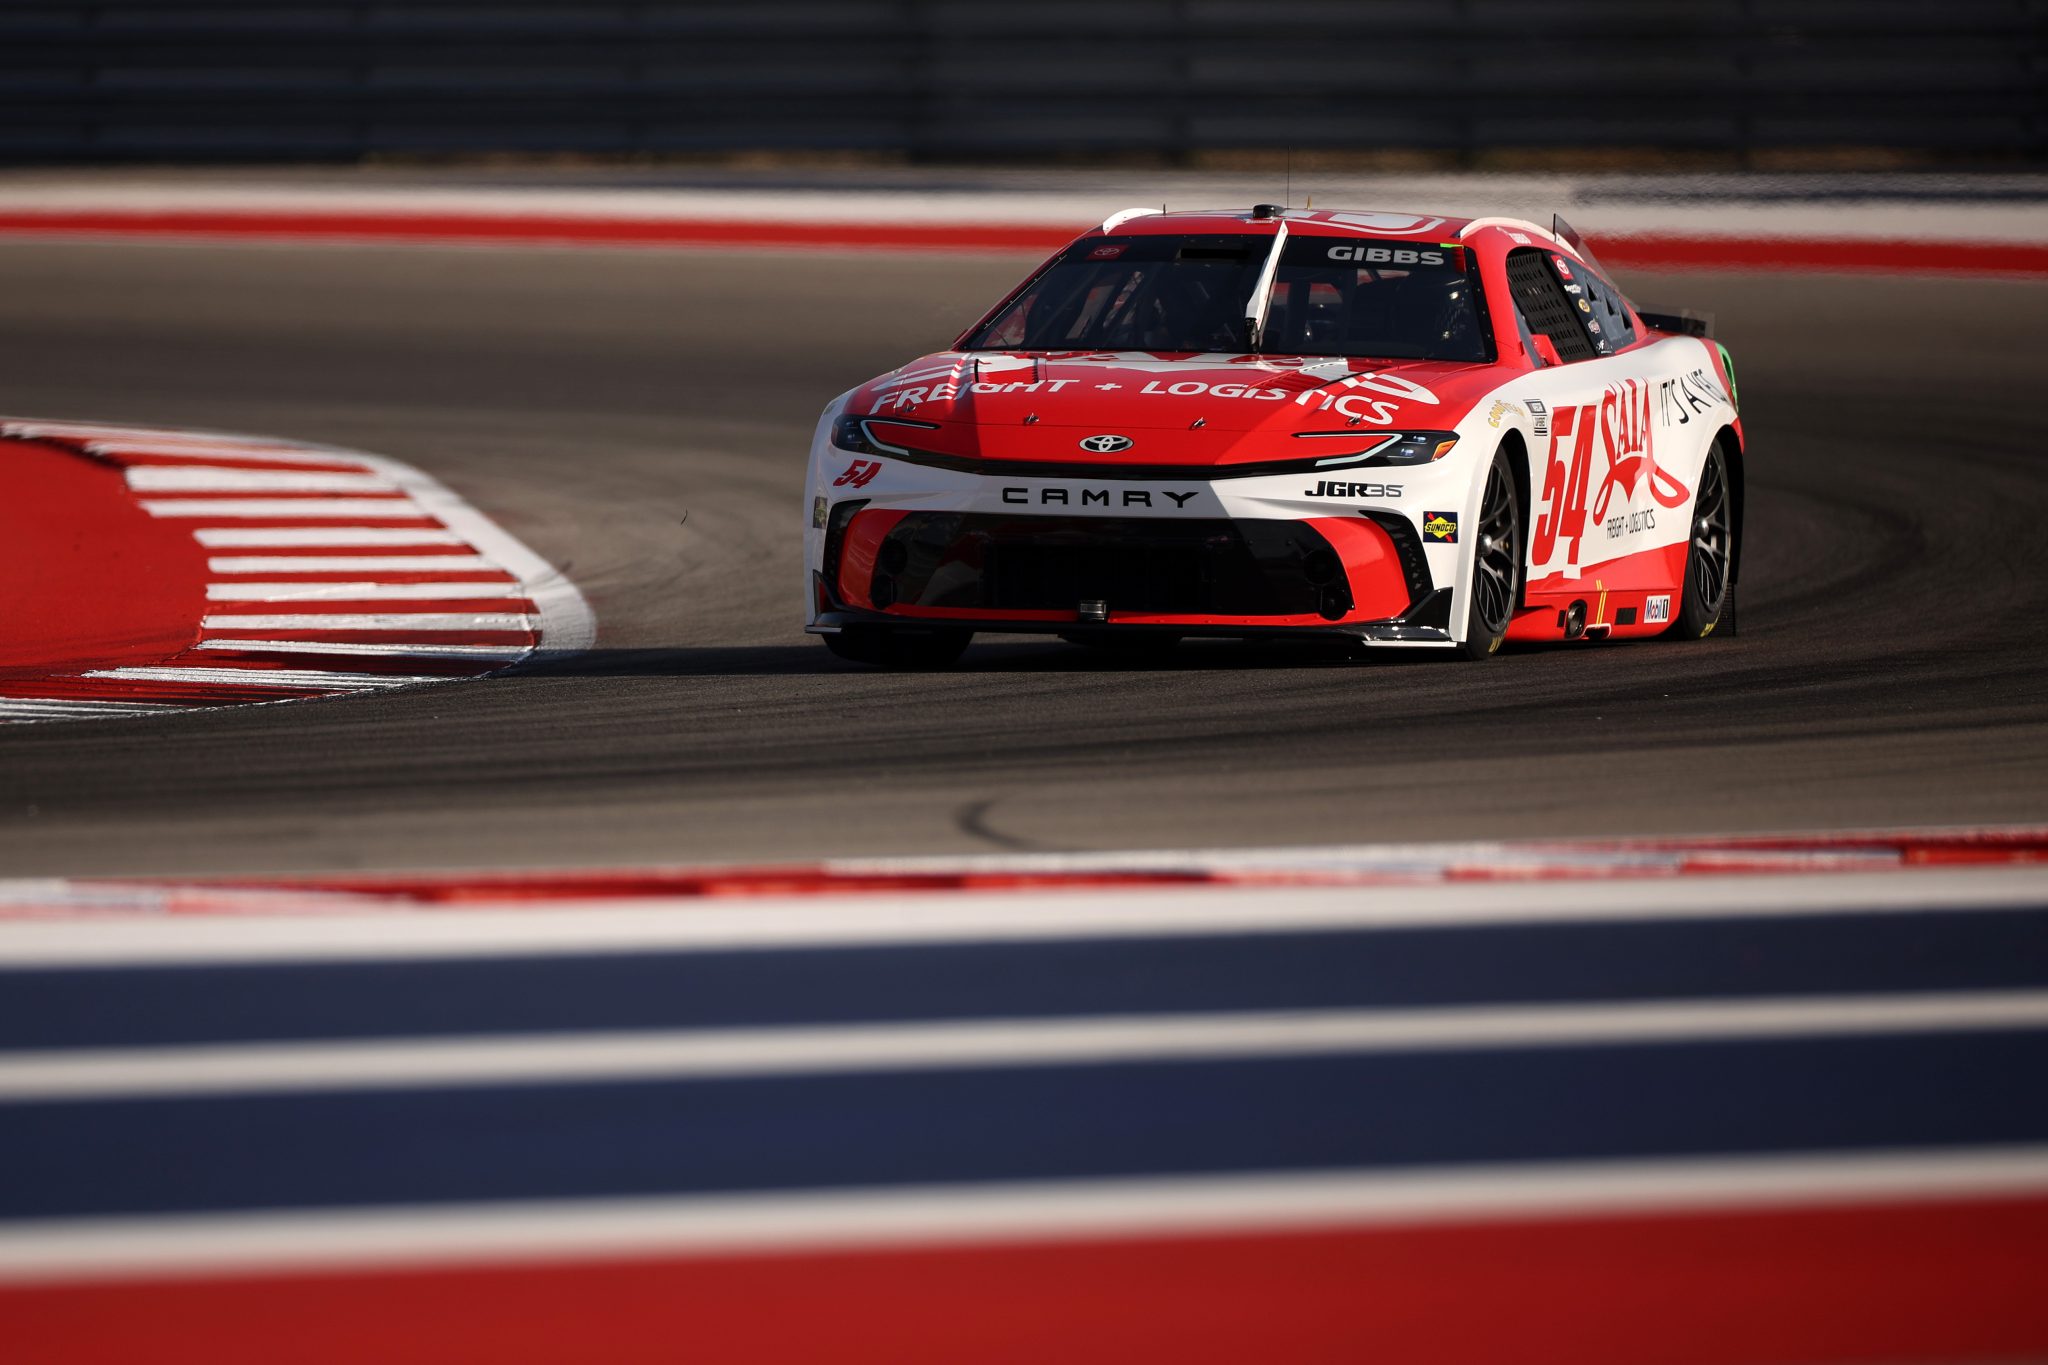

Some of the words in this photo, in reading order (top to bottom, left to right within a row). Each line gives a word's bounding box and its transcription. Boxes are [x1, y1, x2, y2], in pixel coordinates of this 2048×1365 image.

[1327, 245, 1445, 266] GIBBS
[868, 378, 1081, 415] FREIGHT
[1139, 380, 1400, 425] LOGISTICS
[1680, 376, 1712, 414] A
[832, 459, 883, 489] 54
[1531, 404, 1597, 566] 54
[1002, 487, 1200, 509] CAMRY
[1424, 521, 1456, 534] SUNOCO
